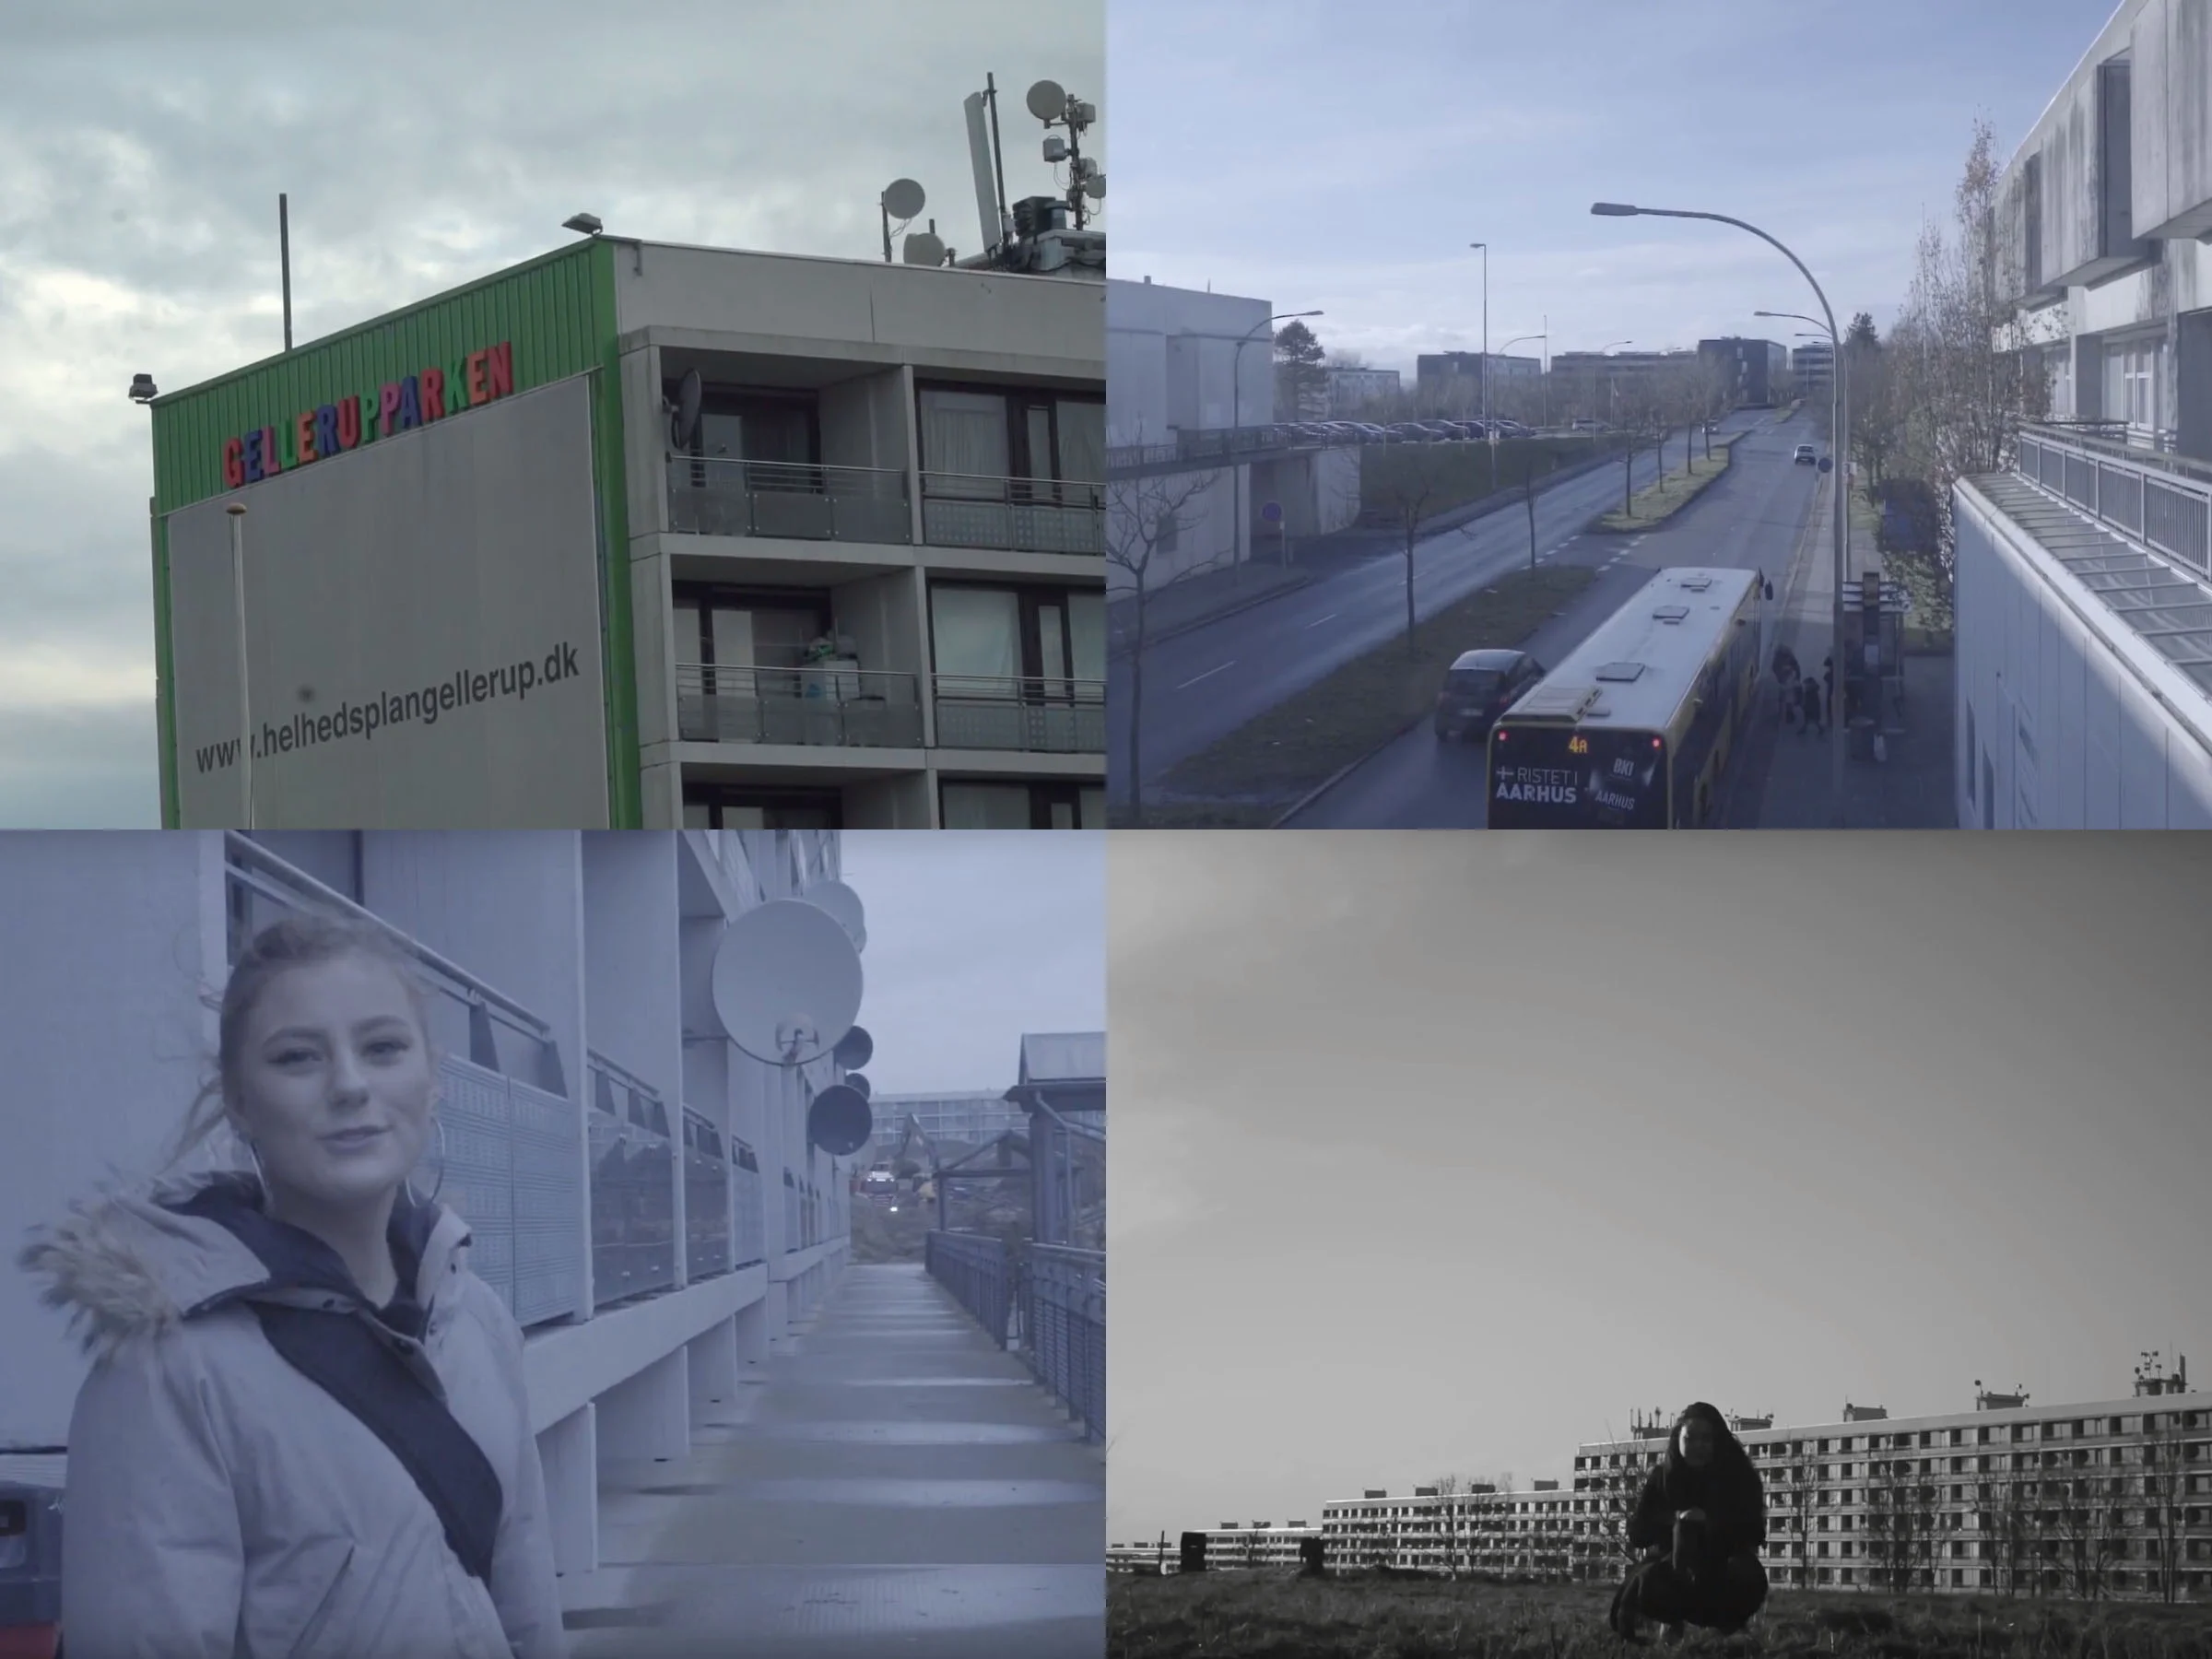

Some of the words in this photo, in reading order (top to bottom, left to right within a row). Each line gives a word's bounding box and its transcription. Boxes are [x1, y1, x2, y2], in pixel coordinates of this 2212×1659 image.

[223, 341, 514, 488] GELLERUPPARKEN
[1569, 735, 1588, 754] 4A
[1517, 767, 1571, 785] RISTET
[1496, 782, 1577, 804] AARHUS
[1594, 790, 1636, 811] AARHUS
